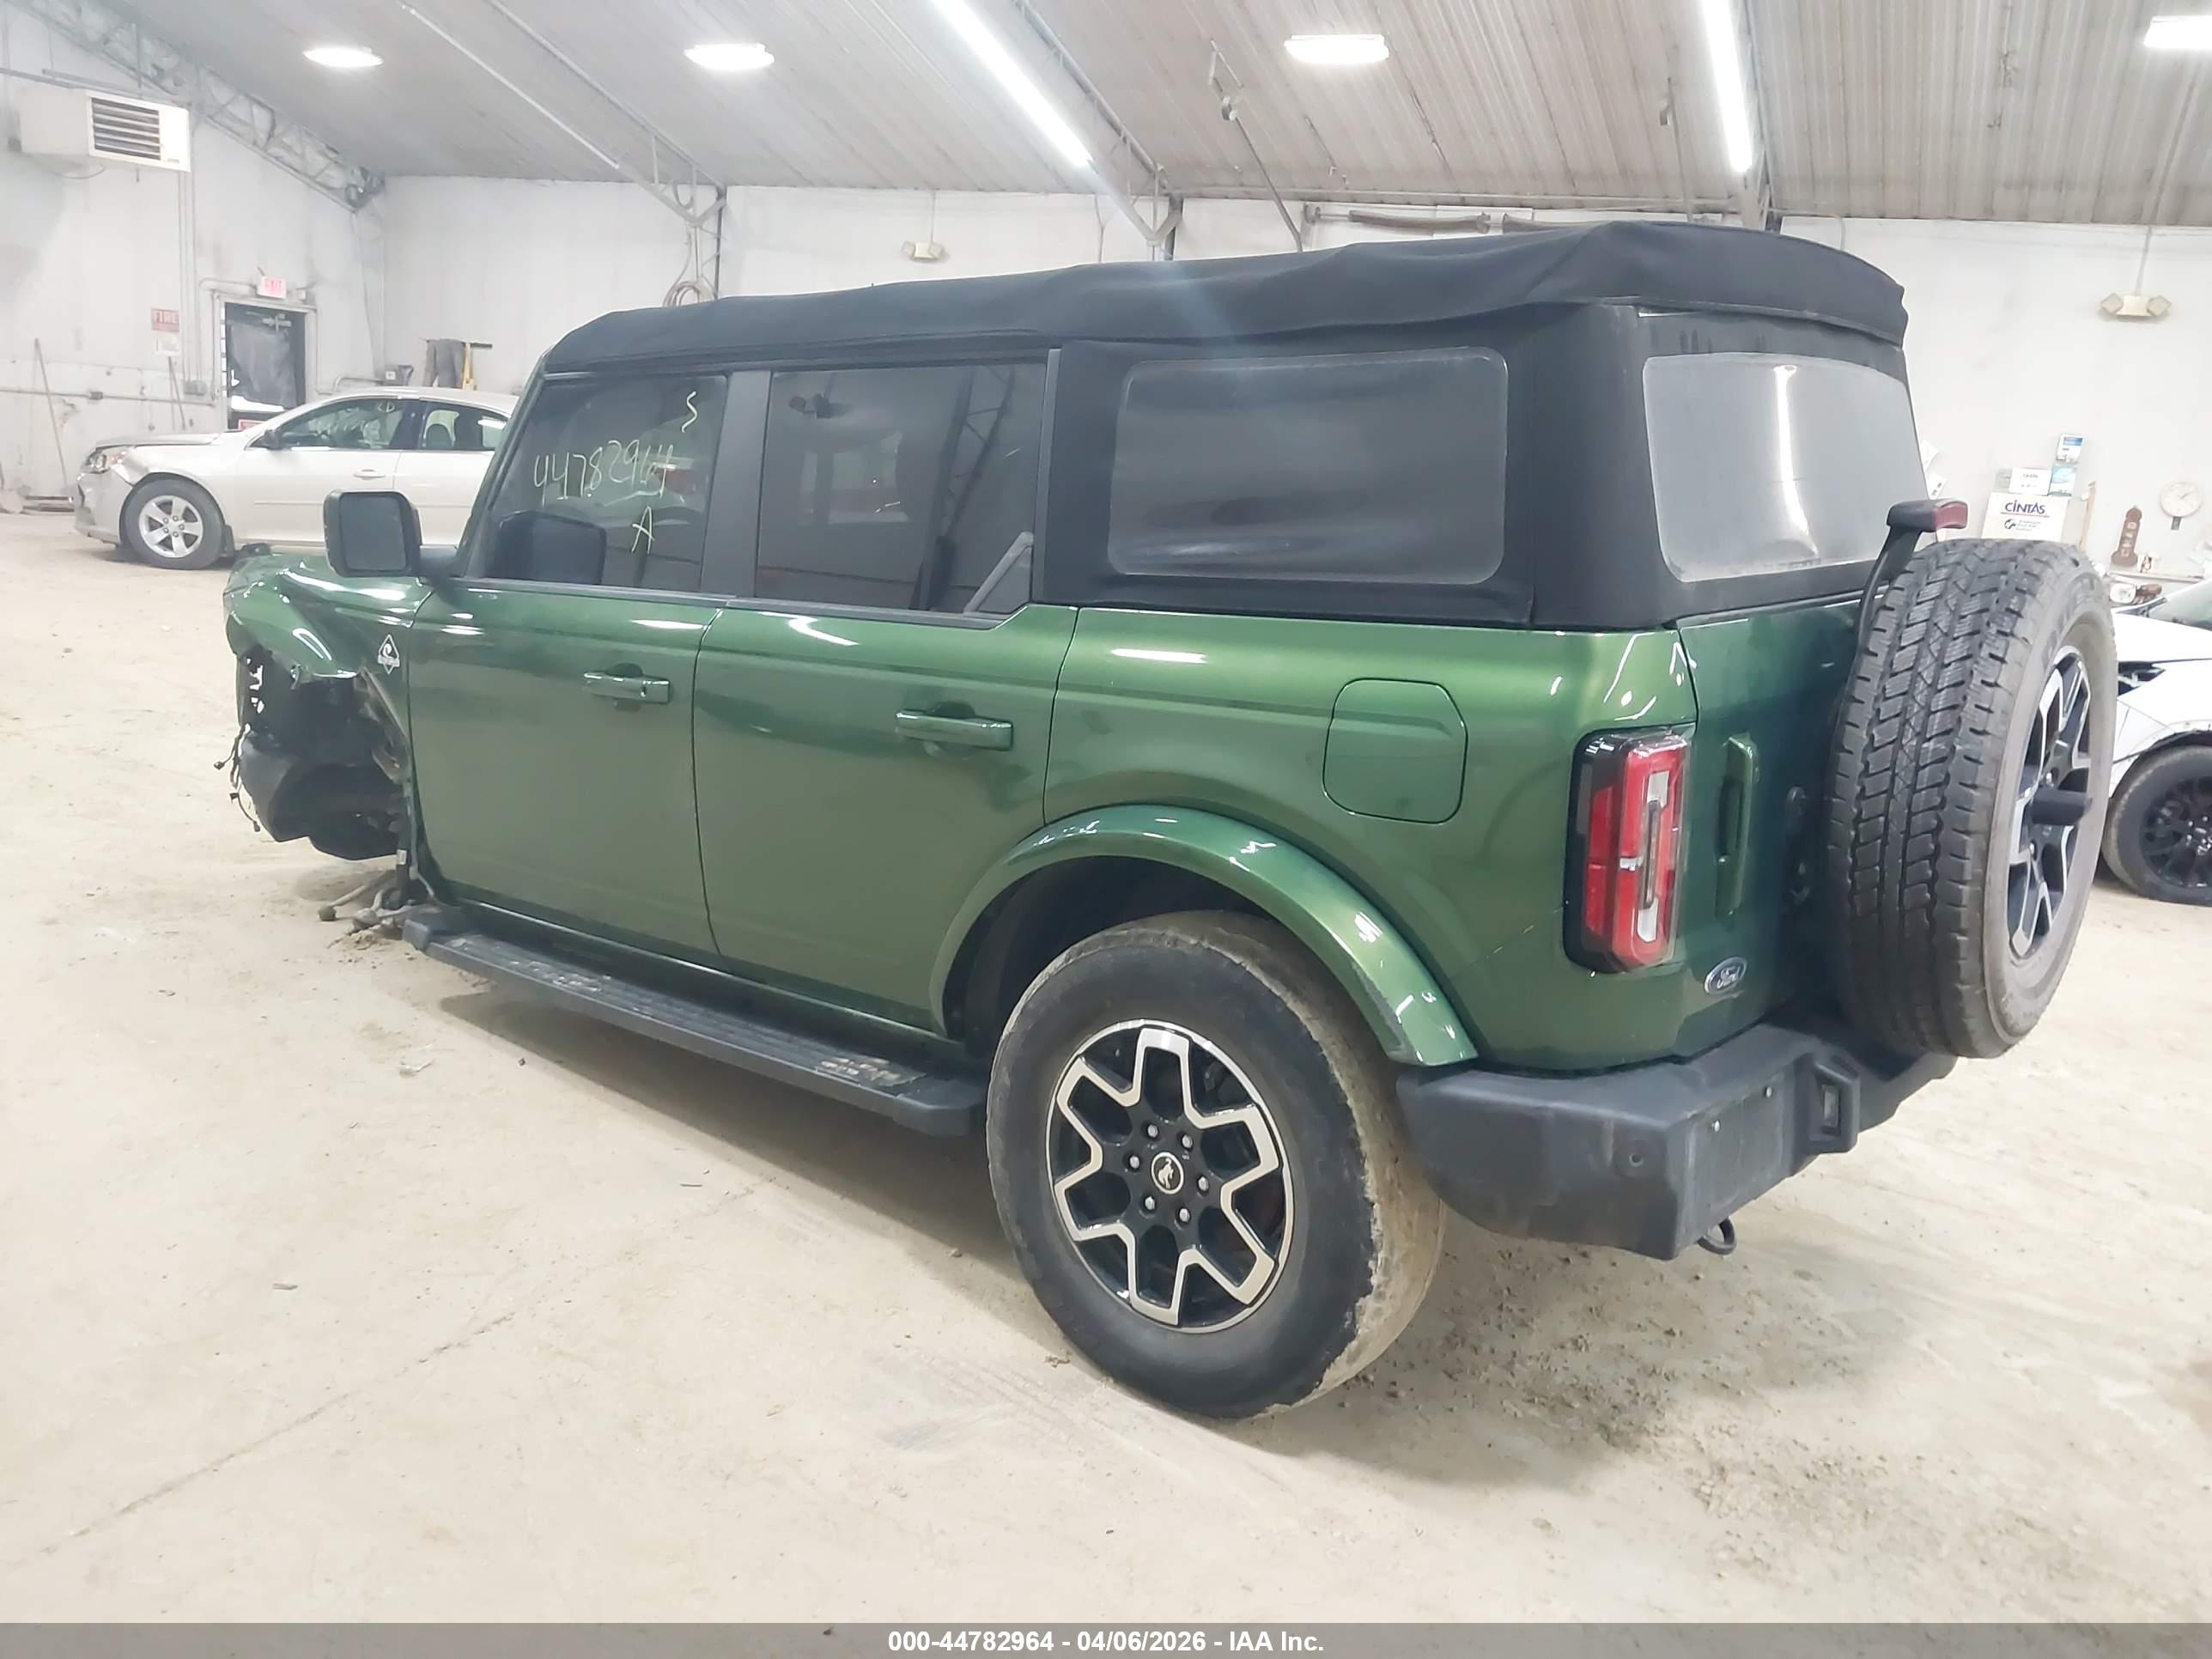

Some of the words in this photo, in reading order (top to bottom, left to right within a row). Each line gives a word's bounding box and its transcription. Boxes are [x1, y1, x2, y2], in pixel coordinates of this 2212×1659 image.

[2004, 499, 2045, 514] CINTAS
[630, 505, 655, 555] A
[1717, 965, 1741, 989] Ford
